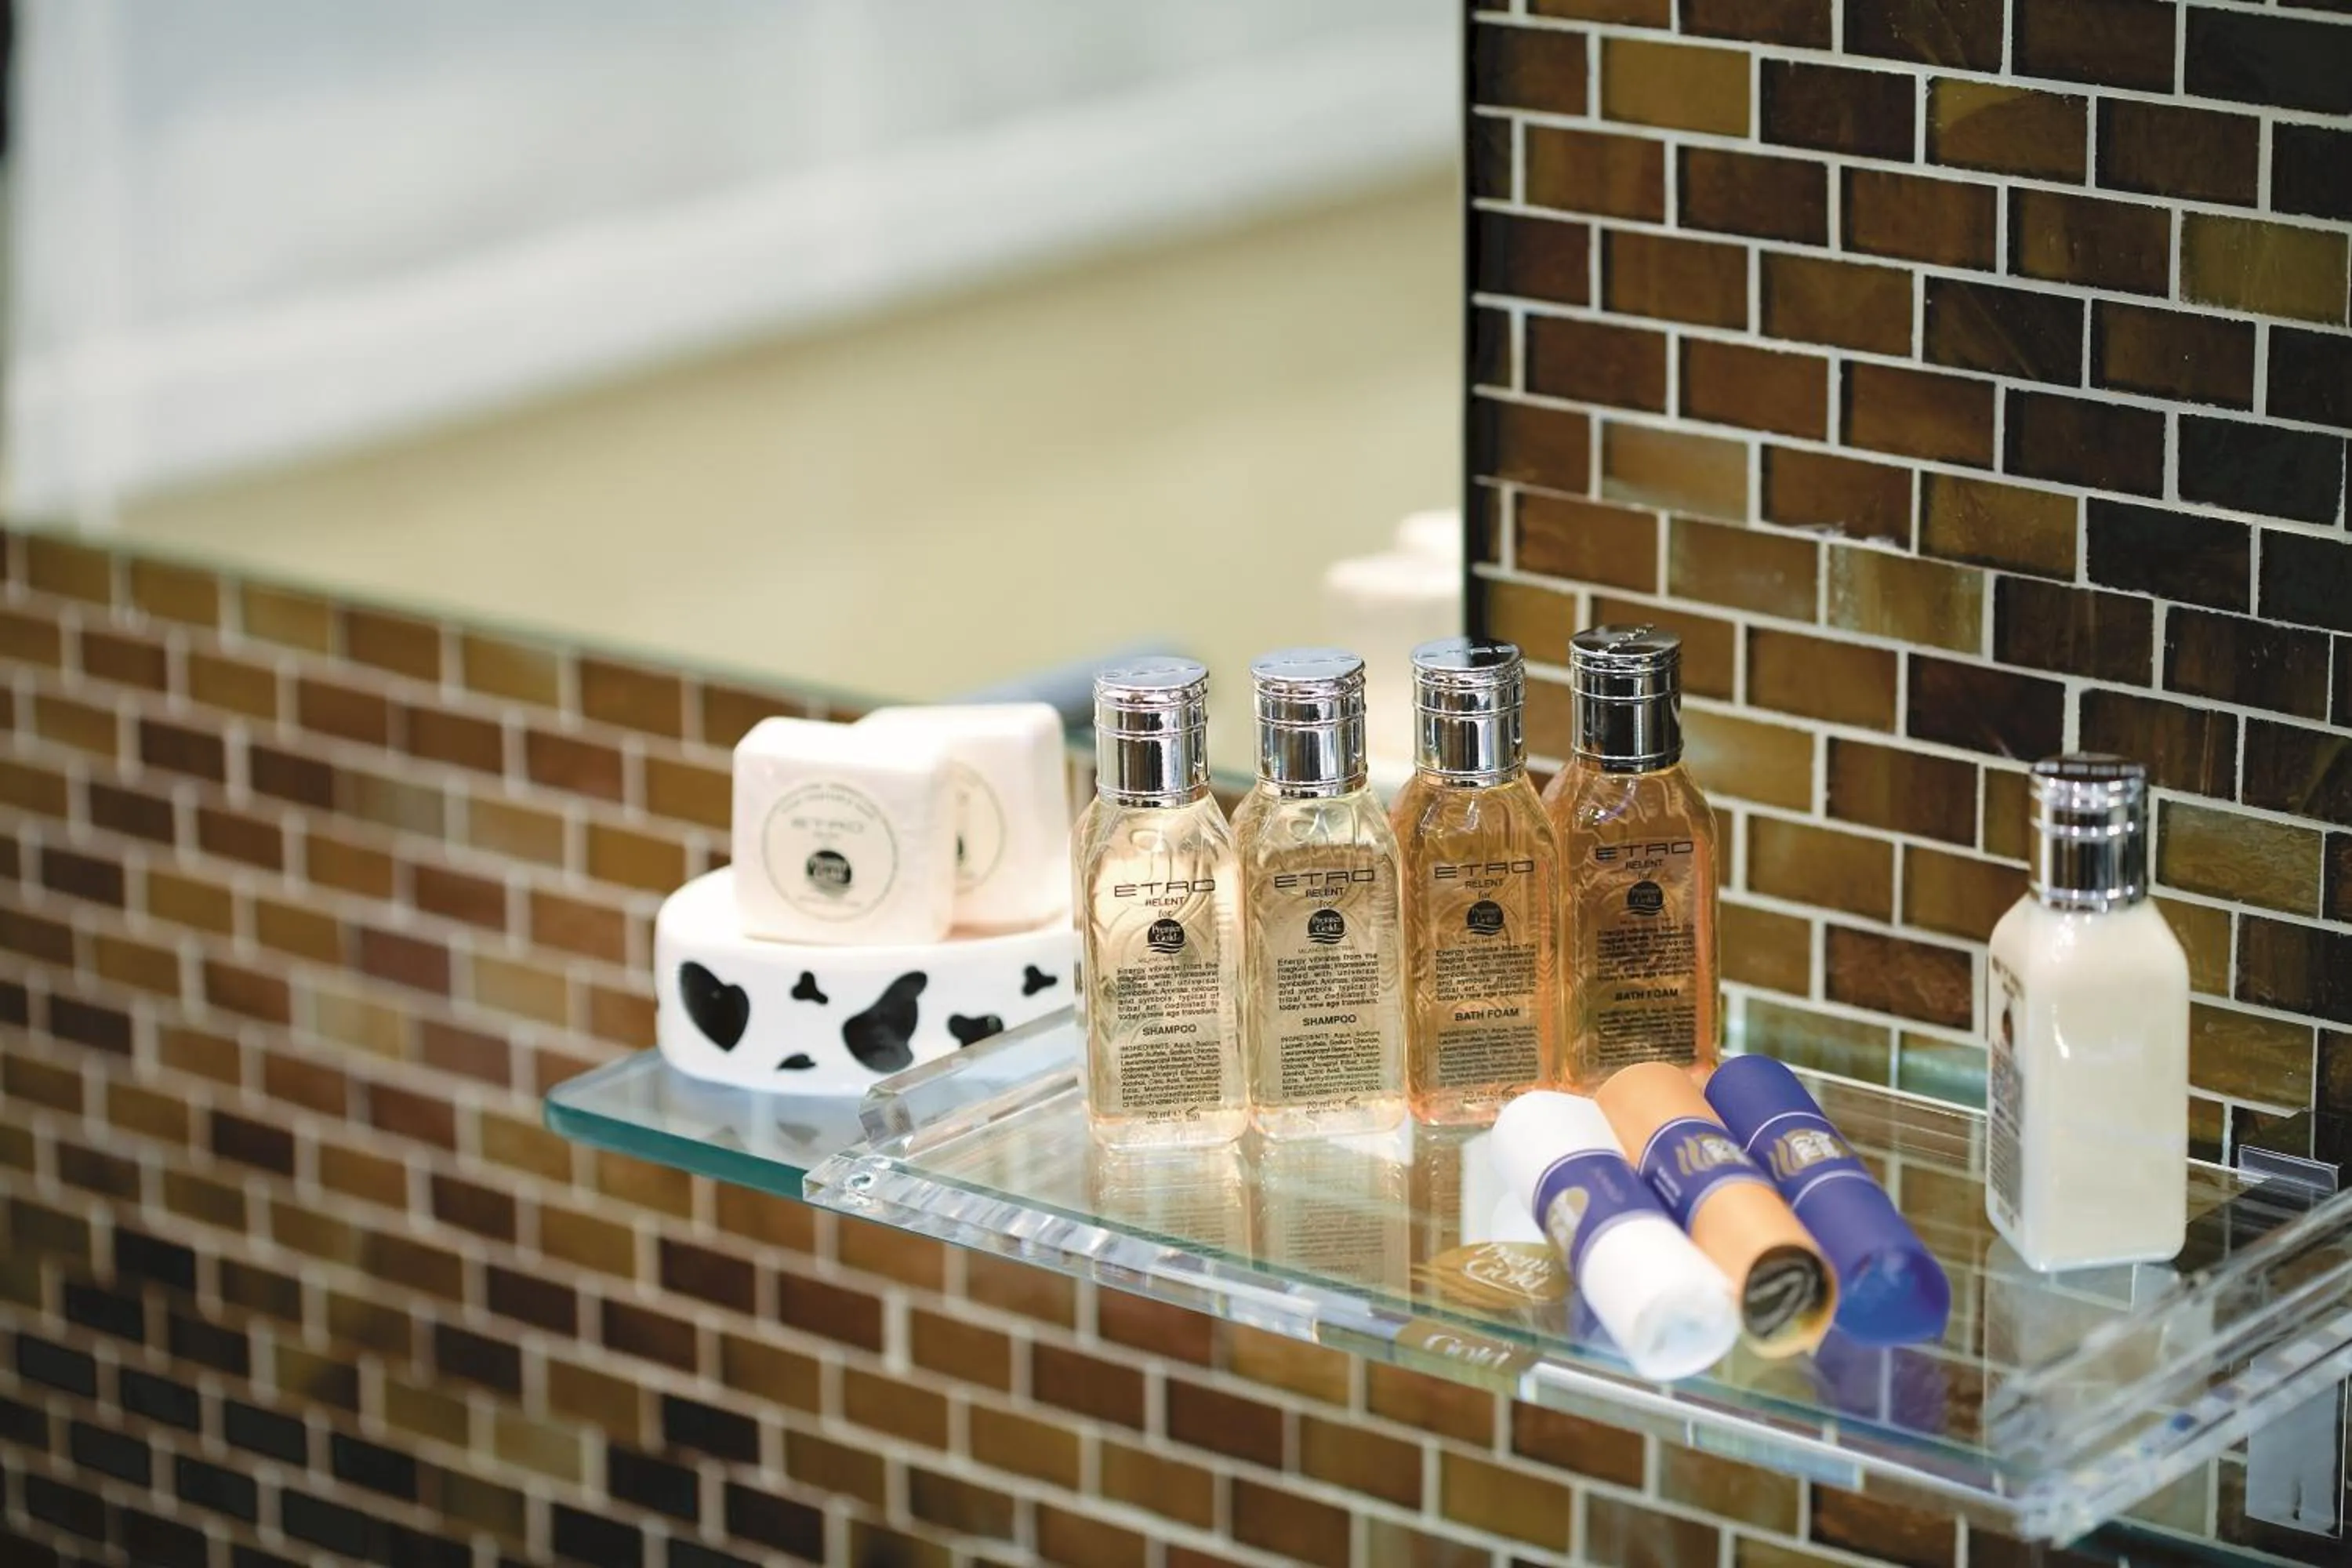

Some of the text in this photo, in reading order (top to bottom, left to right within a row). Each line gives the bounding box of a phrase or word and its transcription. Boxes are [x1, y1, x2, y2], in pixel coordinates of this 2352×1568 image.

[1465, 877, 1504, 889] RELENT
[1305, 887, 1345, 898] RELENT
[1145, 896, 1185, 907] RELENT
[1615, 990, 1644, 1001] BATH
[1302, 1014, 1357, 1026] SHAMPOO
[1455, 1007, 1519, 1022] BATH FOAM
[1142, 1023, 1197, 1036] SHAMPOO
